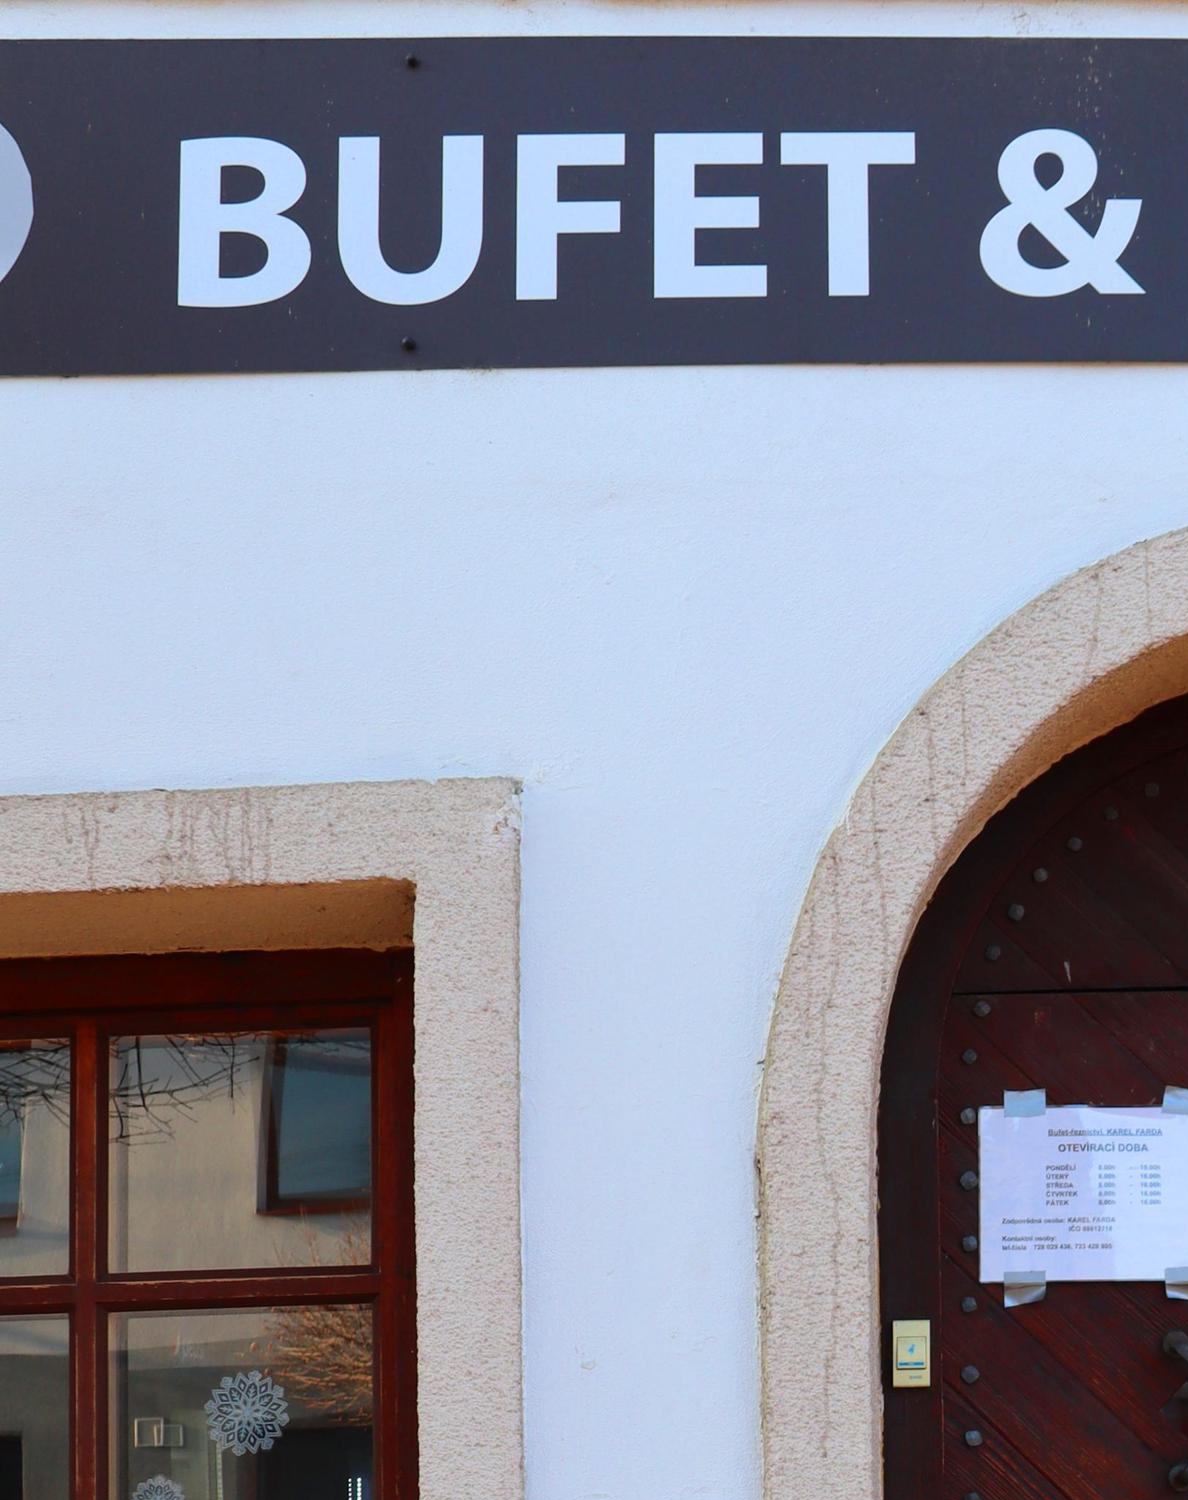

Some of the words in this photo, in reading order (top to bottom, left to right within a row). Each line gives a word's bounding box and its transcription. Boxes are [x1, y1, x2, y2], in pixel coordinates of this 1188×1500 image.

[178, 131, 916, 308] BUFET
[979, 128, 1147, 298] &
[1106, 1128, 1133, 1137] KAREL
[1058, 1141, 1115, 1152] OTEVÍRACÍ
[1118, 1142, 1149, 1152] DOBA
[1046, 1163, 1077, 1171] PONDĚLÍ
[1046, 1181, 1074, 1189] STŘEDA
[1046, 1198, 1070, 1206] PÁTEK
